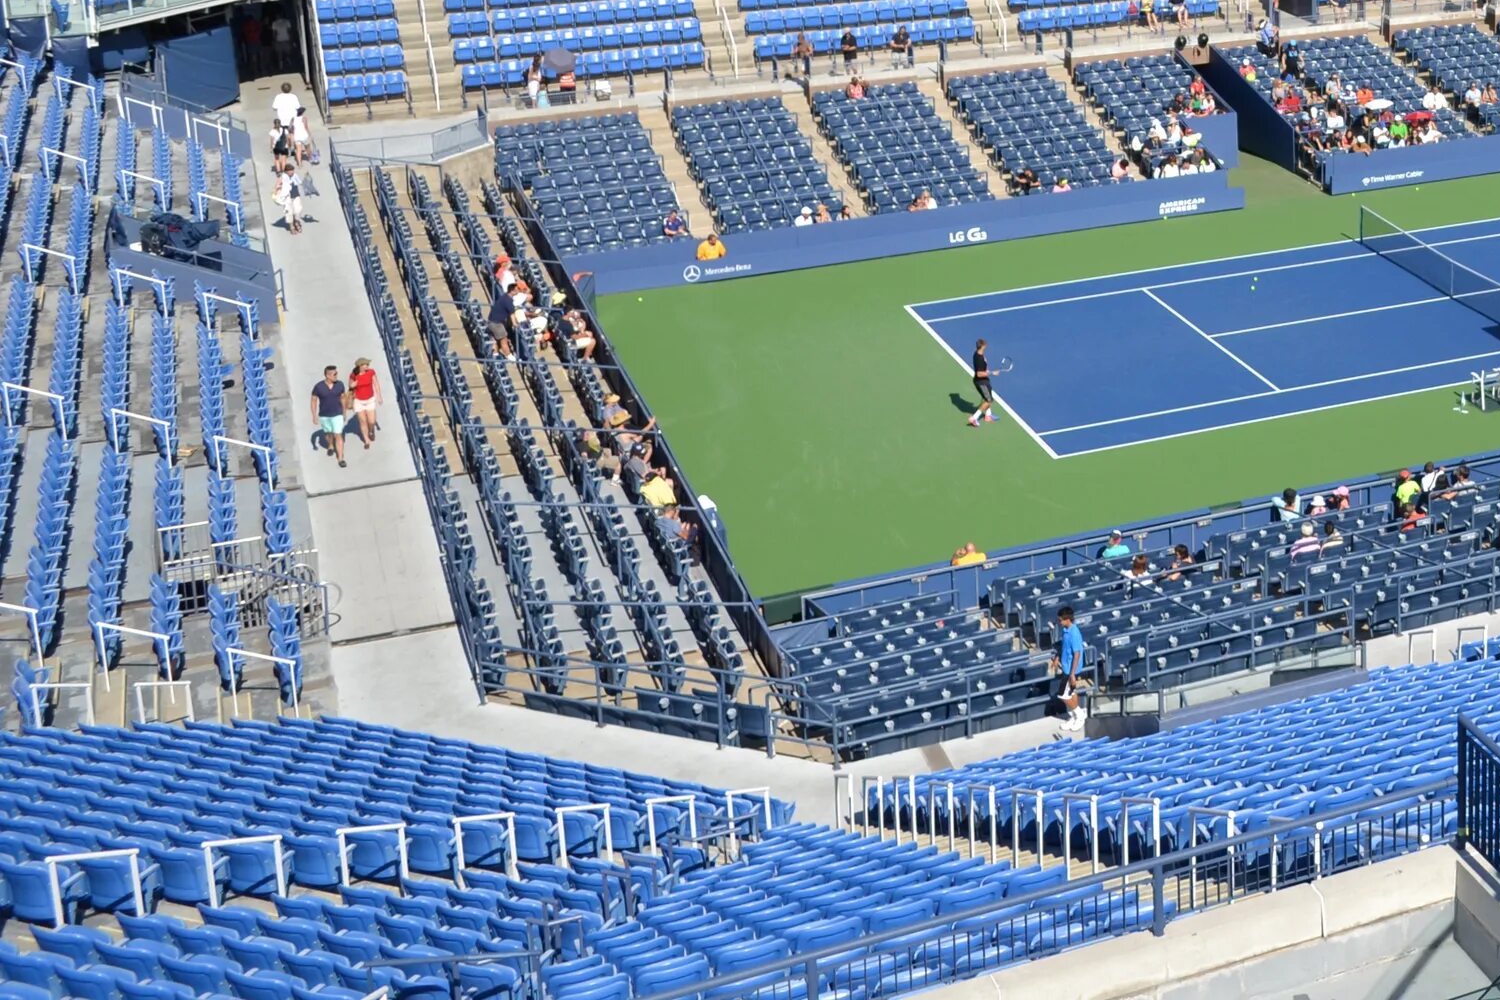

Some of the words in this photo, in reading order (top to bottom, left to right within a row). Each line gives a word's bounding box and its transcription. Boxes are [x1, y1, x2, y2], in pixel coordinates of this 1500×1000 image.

[1384, 173, 1406, 181] Warner
[1159, 197, 1205, 209] AMERICAN
[949, 230, 965, 243] LG
[704, 264, 752, 275] Mercedes-Benz
